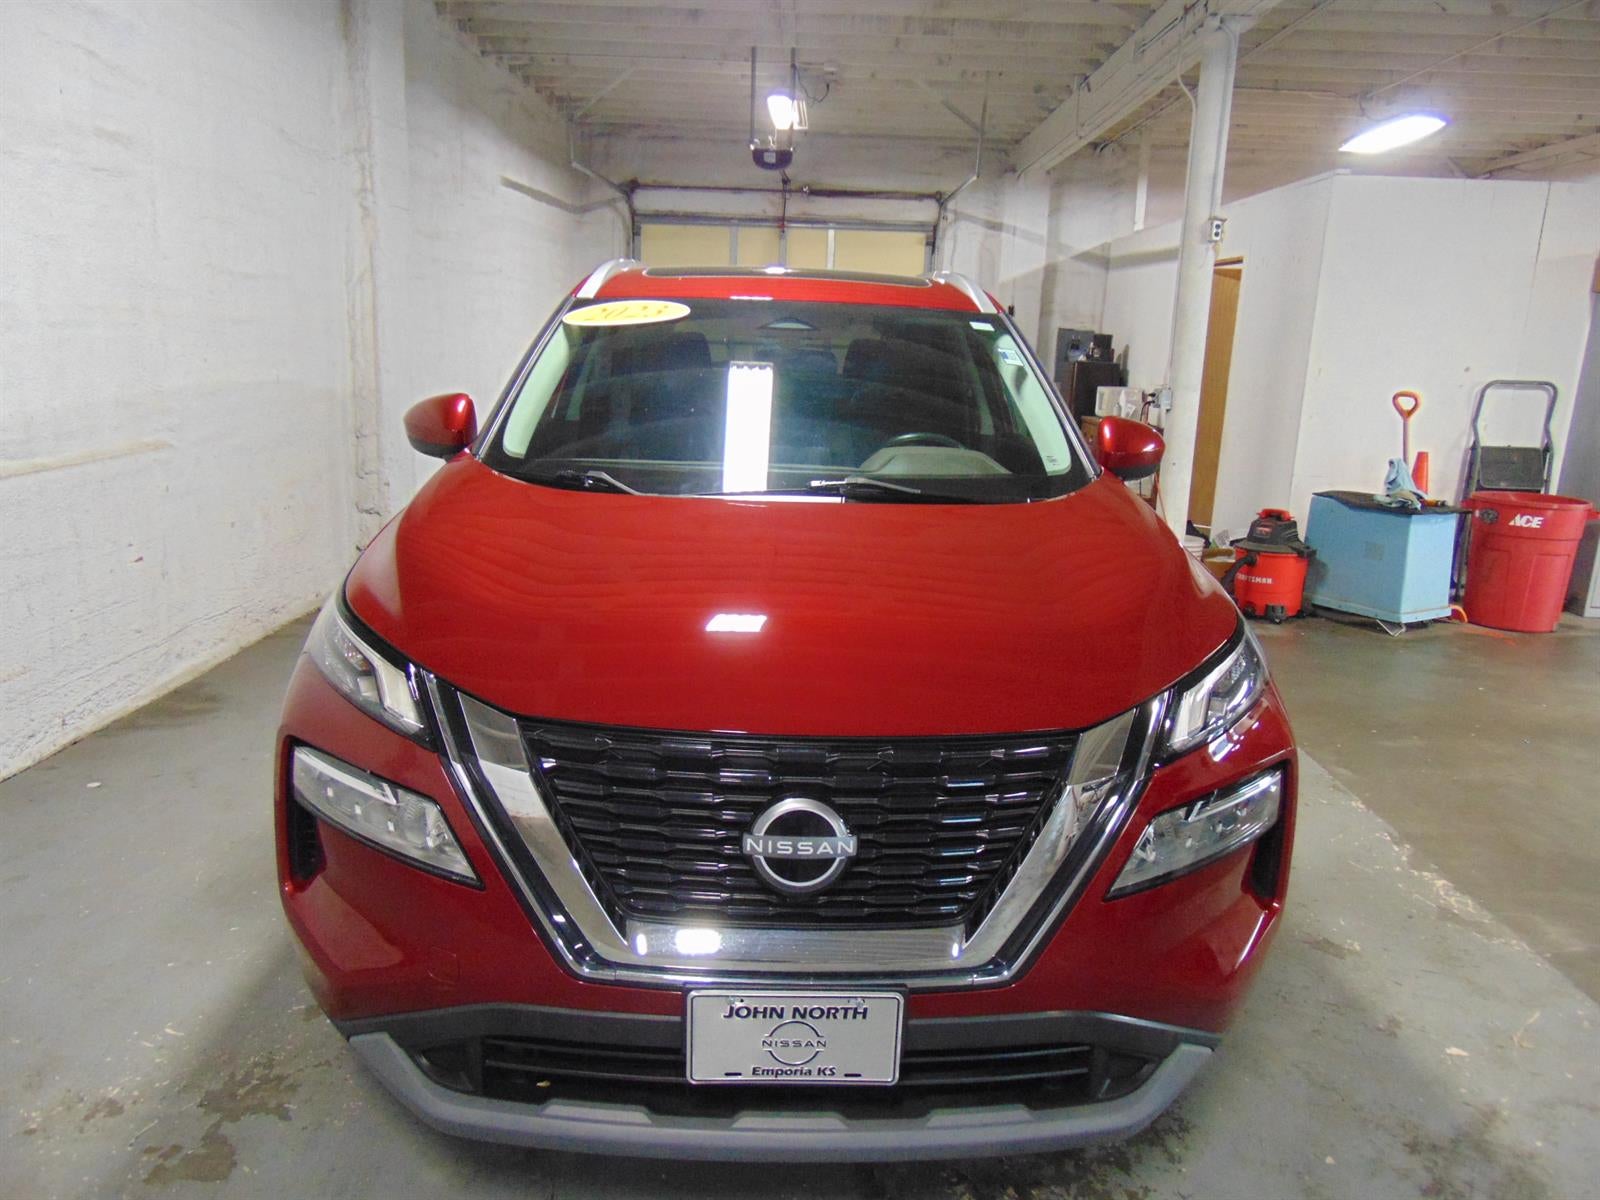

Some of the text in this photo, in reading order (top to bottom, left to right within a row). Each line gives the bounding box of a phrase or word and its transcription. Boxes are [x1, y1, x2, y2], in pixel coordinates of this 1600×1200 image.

[1508, 514, 1544, 528] ACE
[746, 838, 853, 855] NISSAN
[723, 1005, 868, 1020] JOHN NORTH
[762, 1039, 827, 1048] NISSAN
[752, 1066, 836, 1078] Emporia KS
